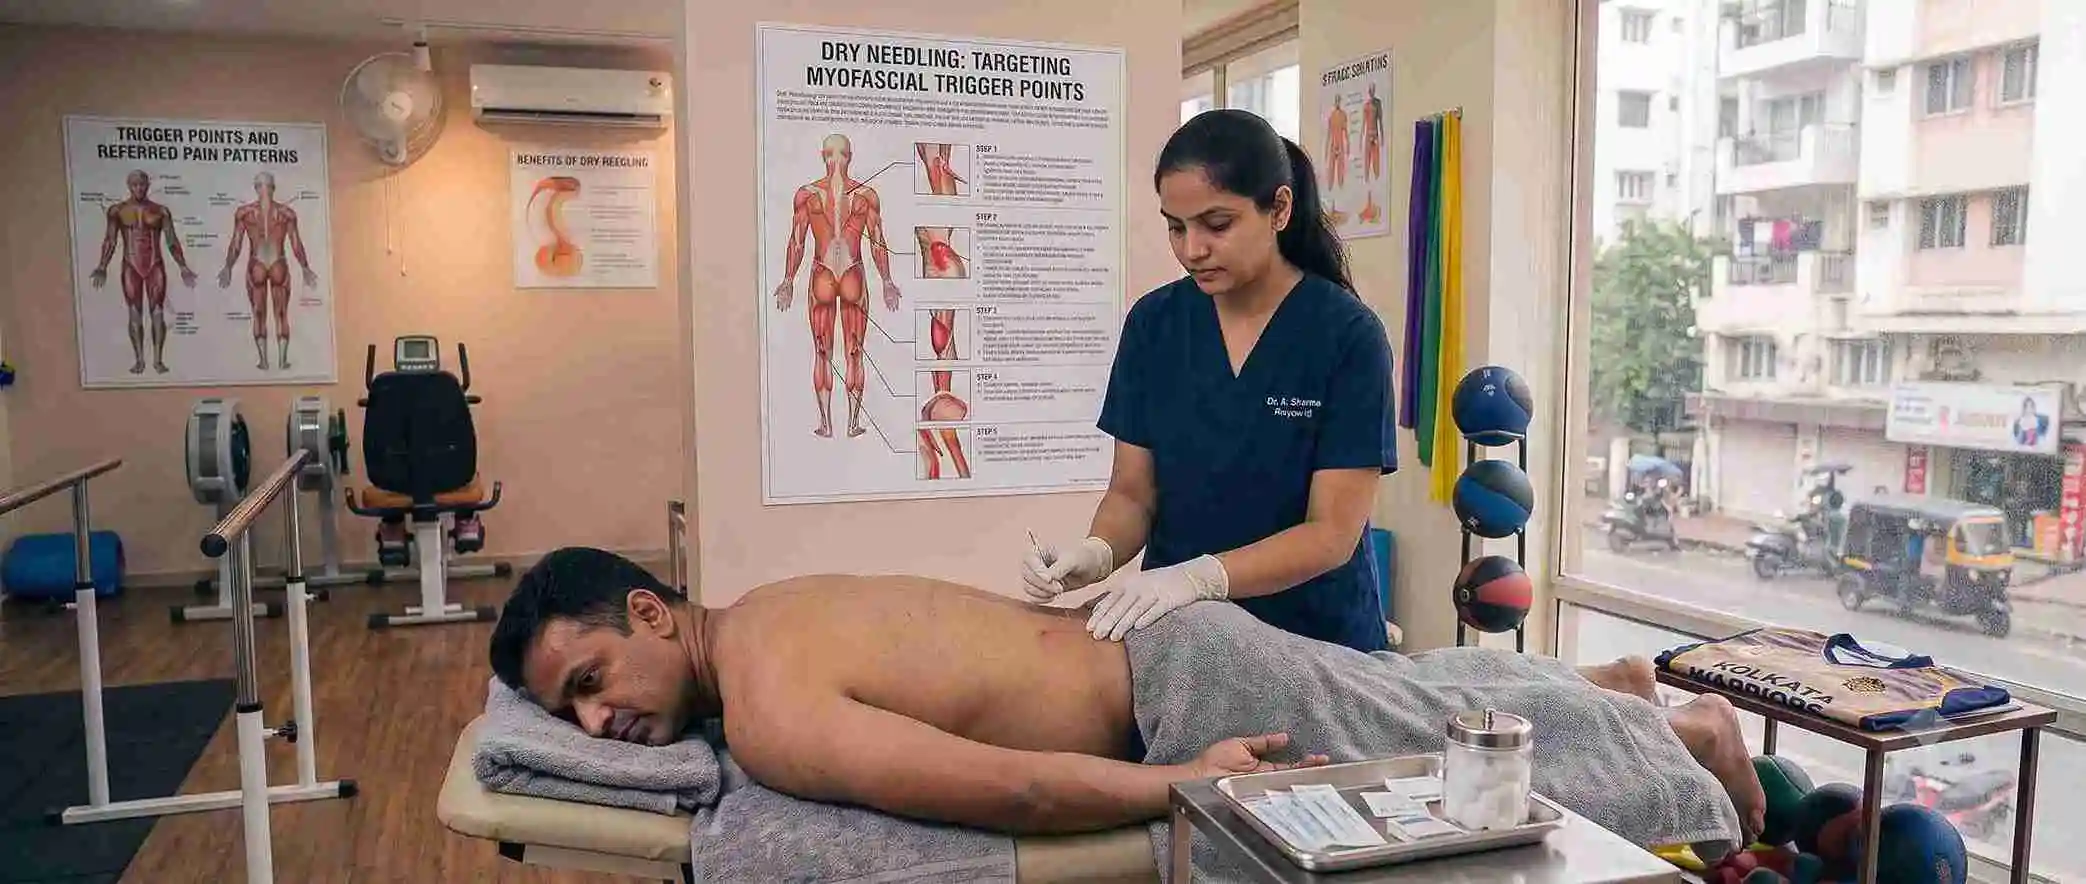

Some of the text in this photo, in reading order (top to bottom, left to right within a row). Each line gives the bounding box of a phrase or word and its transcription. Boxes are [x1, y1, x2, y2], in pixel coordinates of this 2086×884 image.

[821, 41, 1072, 76] DRY NEEDLING: TARGETING
[806, 67, 1085, 101] MYOFASCIAL TRIGGER POINTS
[116, 127, 279, 145] TRIGGER POINTS AND
[97, 144, 298, 163] REFERRED PAIN PATTERNS
[517, 154, 563, 165] BENEFITS
[565, 155, 577, 166] OF
[580, 155, 600, 167] DRY
[1712, 661, 1834, 704] KOLKATA
